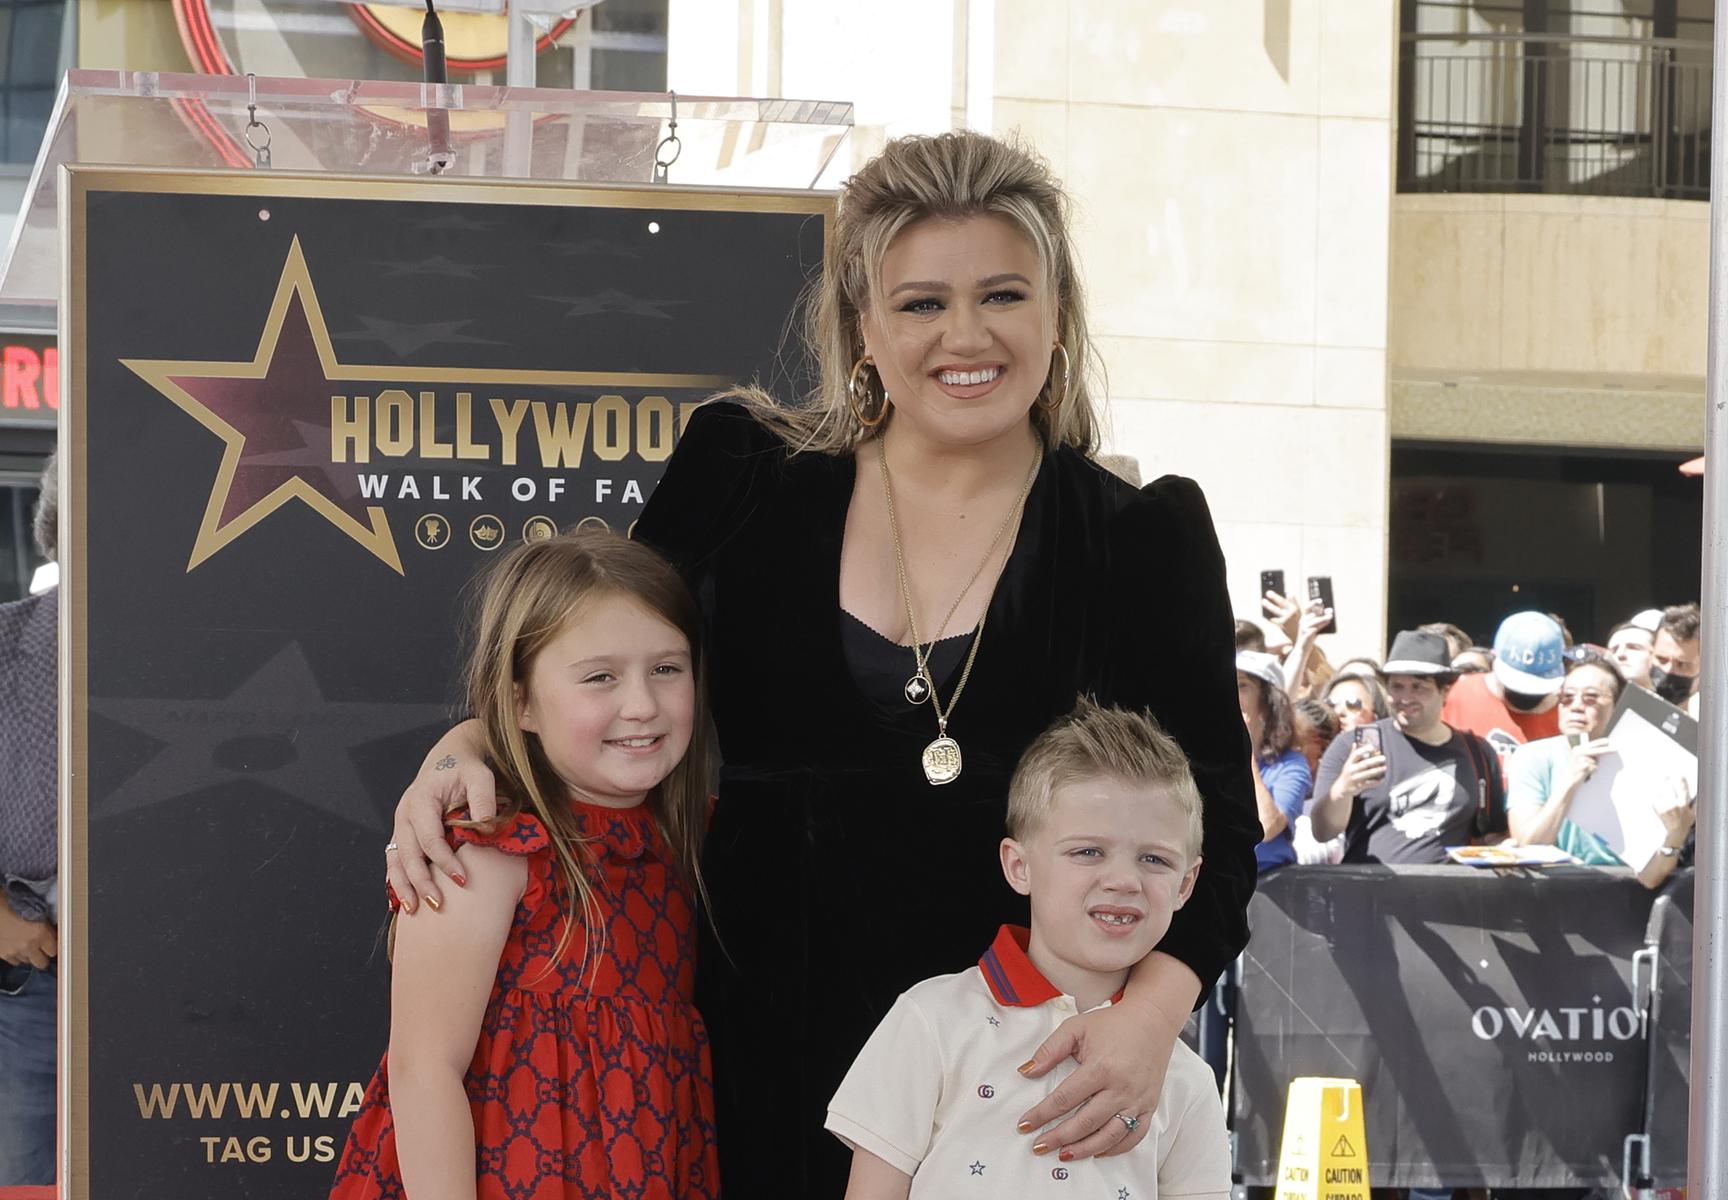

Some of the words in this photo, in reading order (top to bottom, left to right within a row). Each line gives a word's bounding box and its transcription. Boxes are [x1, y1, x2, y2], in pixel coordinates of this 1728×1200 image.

[358, 474, 483, 501] WALK
[511, 476, 566, 502] OF
[595, 478, 661, 504] FA
[1527, 1051, 1614, 1063] HOLLYWOOD
[200, 1136, 272, 1164] TAG
[286, 1135, 336, 1164] US
[1325, 1168, 1362, 1184] CAUTION
